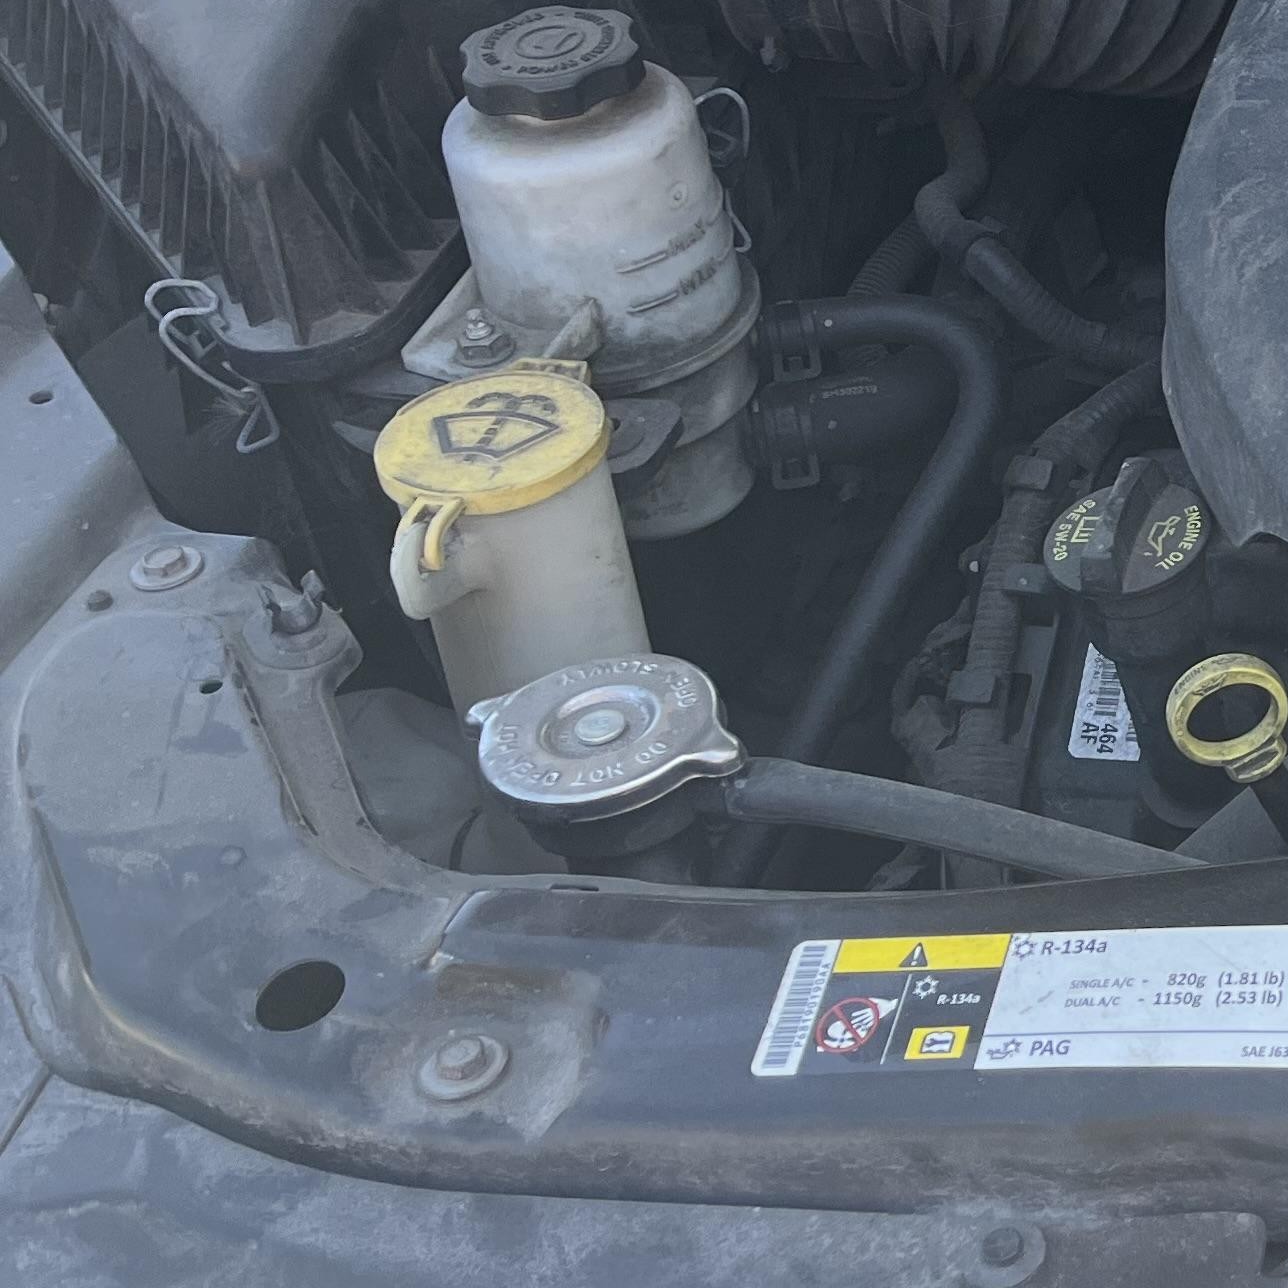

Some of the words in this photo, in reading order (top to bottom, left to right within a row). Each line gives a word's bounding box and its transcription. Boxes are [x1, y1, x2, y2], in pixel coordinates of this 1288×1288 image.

[1178, 505, 1202, 551] ENGINE
[1052, 523, 1073, 561] 5W-20
[1154, 551, 1184, 570] OIL
[1080, 721, 1100, 746] AF
[1096, 722, 1119, 754] 464
[634, 742, 668, 764] DO
[570, 762, 625, 787] NOT
[1041, 939, 1107, 955] R-134a
[1070, 979, 1111, 990] SINGLE
[1112, 977, 1134, 987] A/C
[1167, 973, 1207, 988] 820g
[1218, 971, 1258, 987] (1.81
[1264, 971, 1285, 987] lb)
[937, 993, 981, 1005] R-134a
[1064, 998, 1099, 1008] DUAL
[1099, 996, 1121, 1007] A/C
[1152, 992, 1203, 1007] 1150g
[1215, 991, 1256, 1006] (2.53
[1261, 991, 1284, 1007] lb)
[1029, 1039, 1071, 1056] PAG
[1241, 1046, 1266, 1058] SAE
